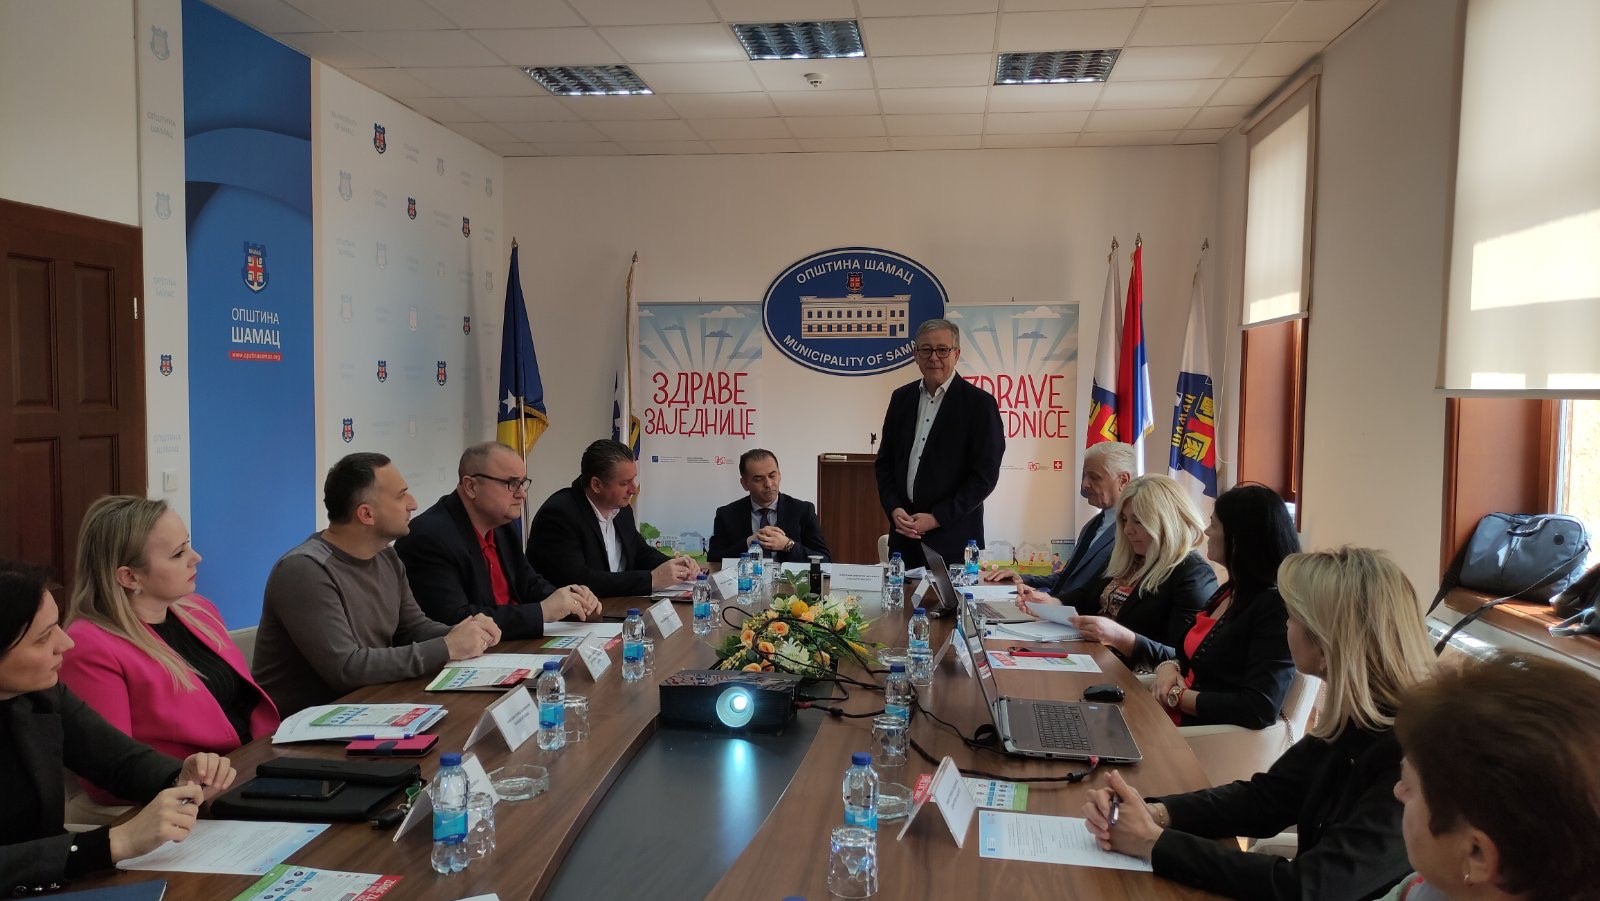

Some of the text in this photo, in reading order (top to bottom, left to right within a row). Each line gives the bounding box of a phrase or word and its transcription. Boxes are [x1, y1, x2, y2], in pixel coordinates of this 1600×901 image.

[796, 259, 914, 286] ОПШТИНА ШАМАЦ
[231, 307, 280, 325] ОПШТИНА
[231, 326, 281, 349] ШАМАЦ
[783, 334, 917, 367] MUNICIPALITY OF SAMA
[652, 371, 749, 408] ЗДРАВЕ
[644, 407, 757, 440] ЗАЈЕДНИЦЕ
[999, 409, 1070, 438] DNICE
